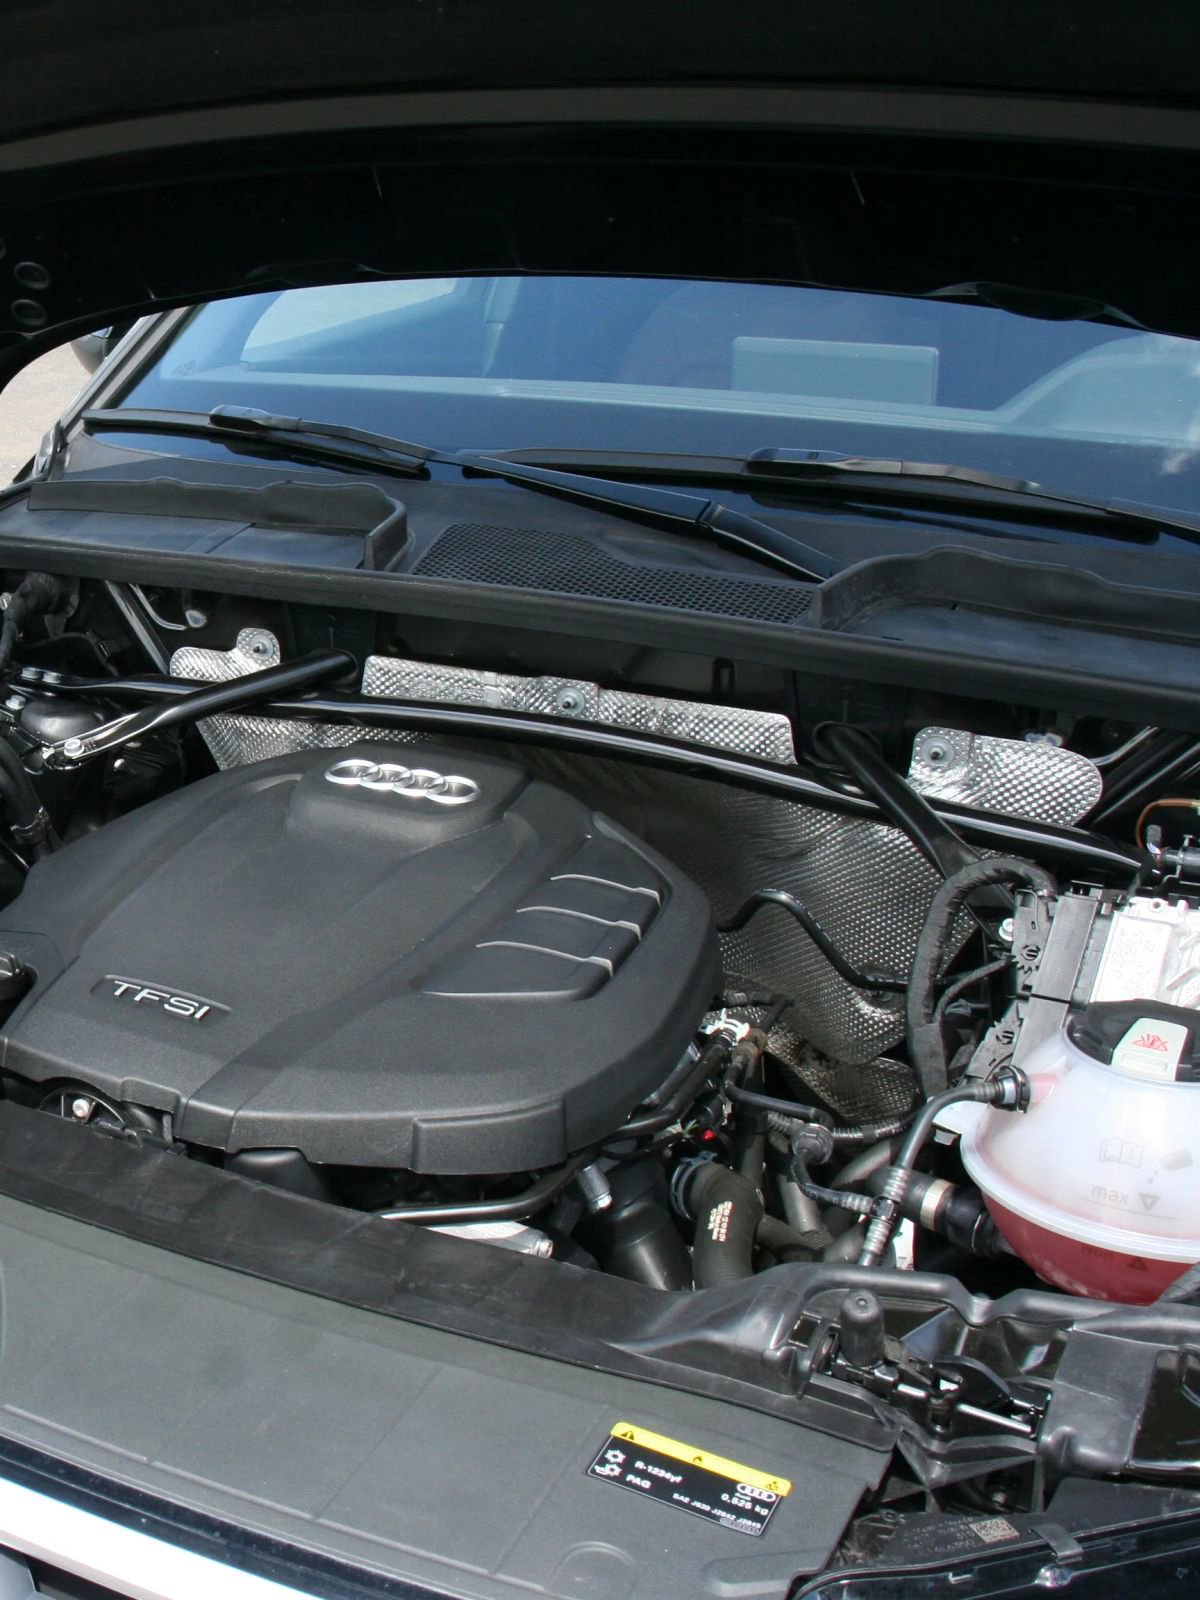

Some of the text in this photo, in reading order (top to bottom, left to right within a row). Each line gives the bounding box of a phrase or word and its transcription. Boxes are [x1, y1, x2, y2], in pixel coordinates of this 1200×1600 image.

[113, 980, 210, 1019] TFSI
[1091, 1186, 1128, 1205] max
[634, 1461, 683, 1483] R-1234yf
[626, 1474, 651, 1489] PAG
[672, 1493, 690, 1504] SAE
[755, 1503, 769, 1516] kg
